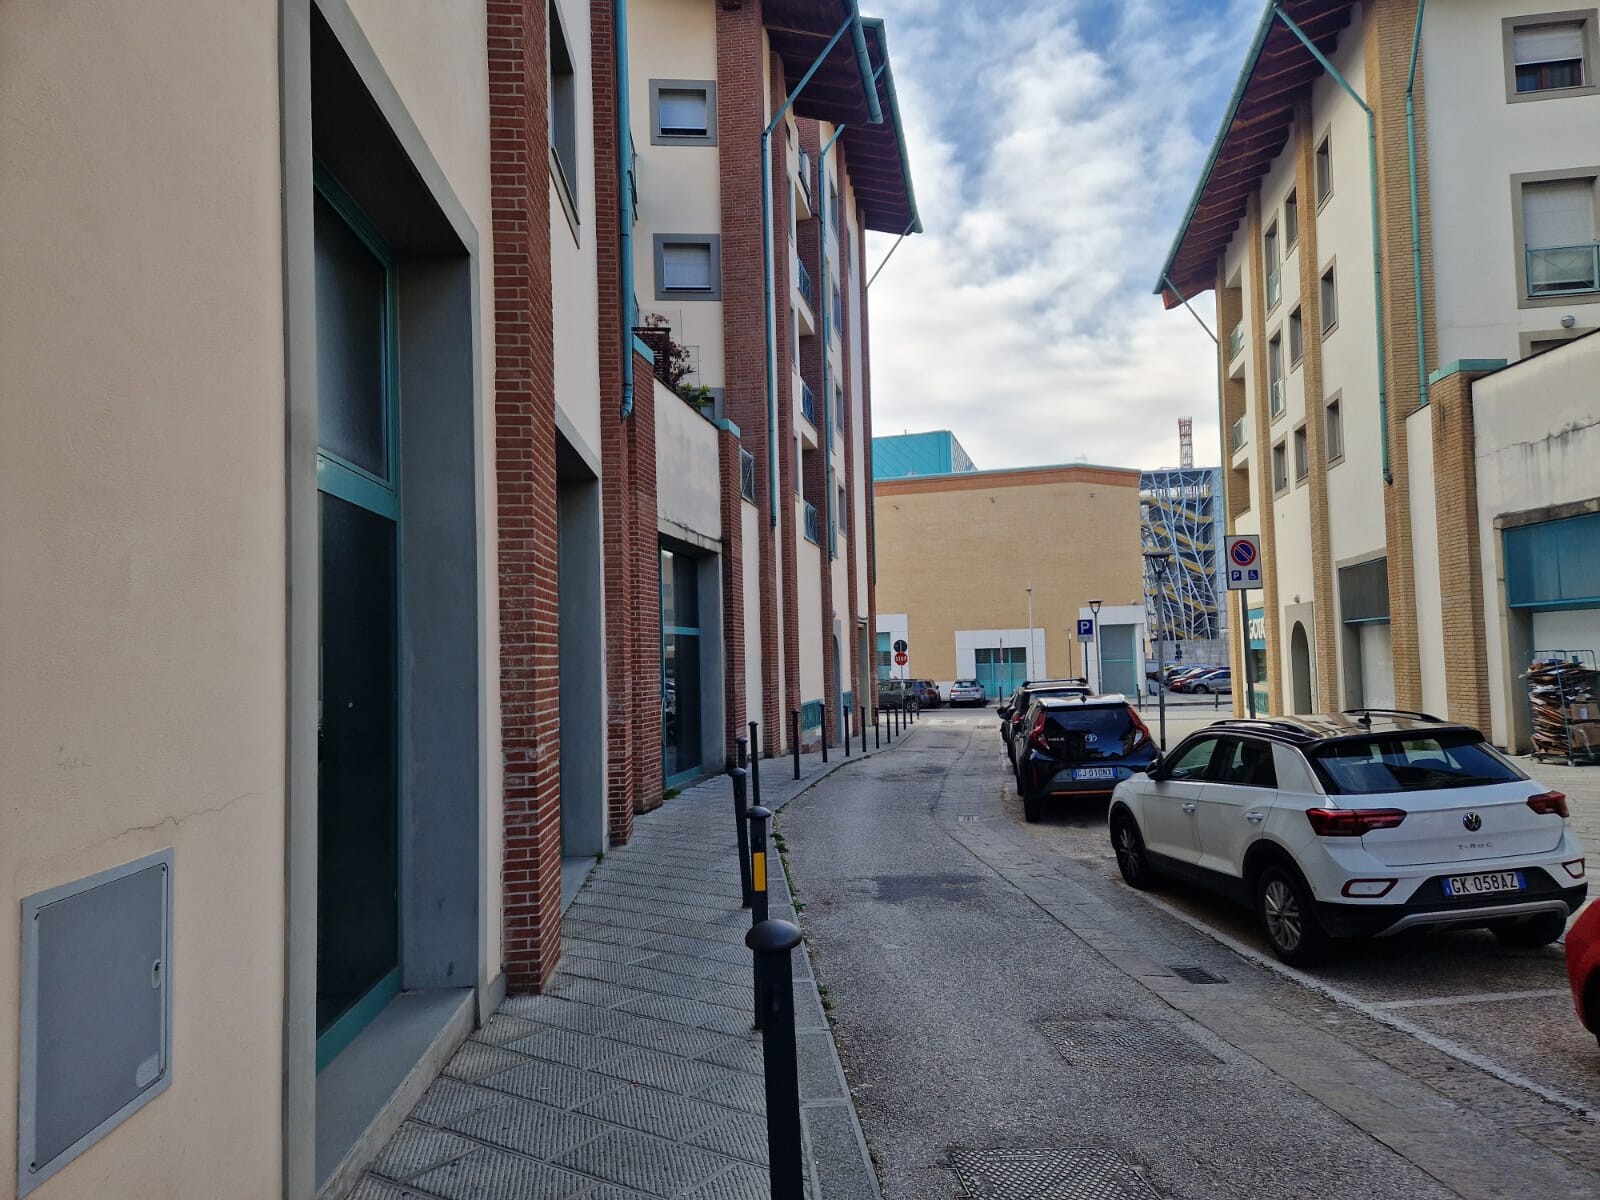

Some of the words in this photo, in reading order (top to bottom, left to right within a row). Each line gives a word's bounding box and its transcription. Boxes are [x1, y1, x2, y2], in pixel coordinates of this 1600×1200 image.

[1233, 571, 1240, 580] P
[1080, 621, 1090, 634] P
[1451, 878, 1470, 894] GK
[1473, 873, 1518, 892] 058AZ
